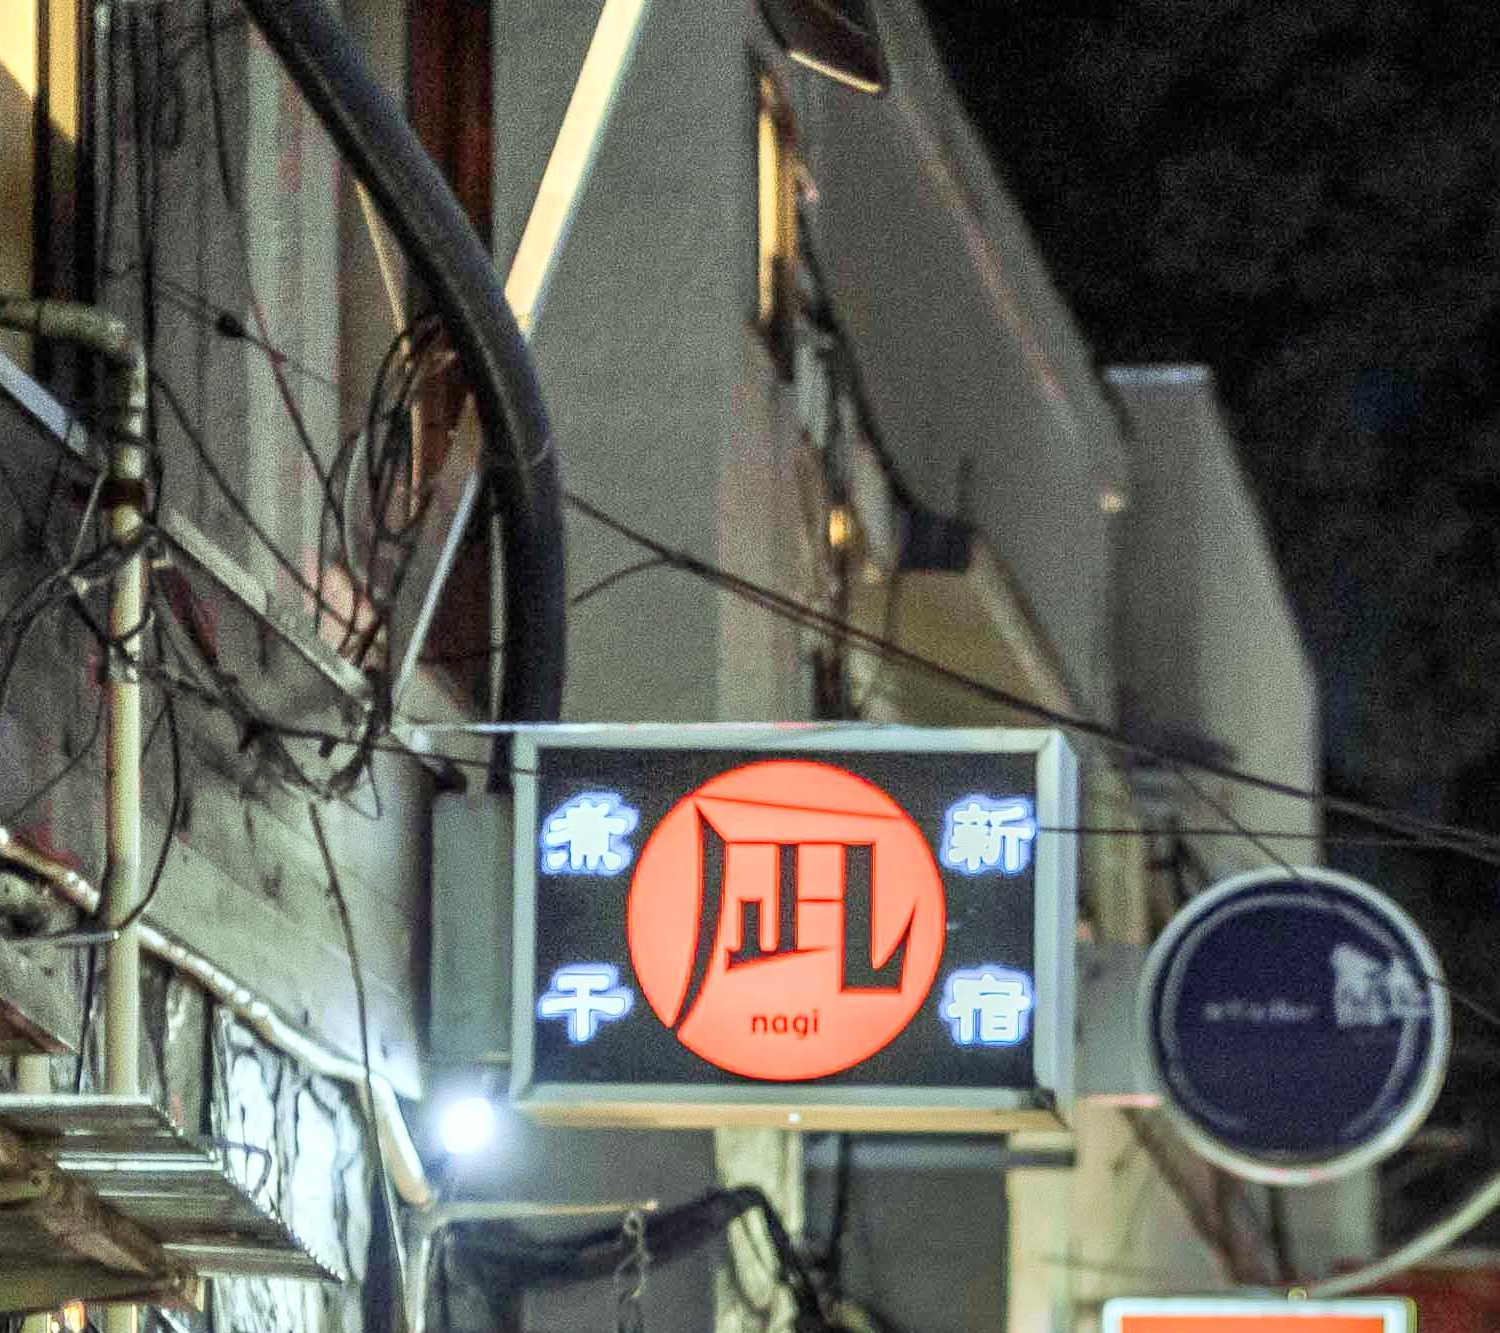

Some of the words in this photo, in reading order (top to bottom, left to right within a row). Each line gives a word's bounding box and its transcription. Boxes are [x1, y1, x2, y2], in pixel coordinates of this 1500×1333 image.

[541, 797, 631, 1043] 煮干
[666, 798, 916, 1028] 凪
[750, 1009, 819, 1036] nagi
[945, 798, 1034, 1043] 新宿
